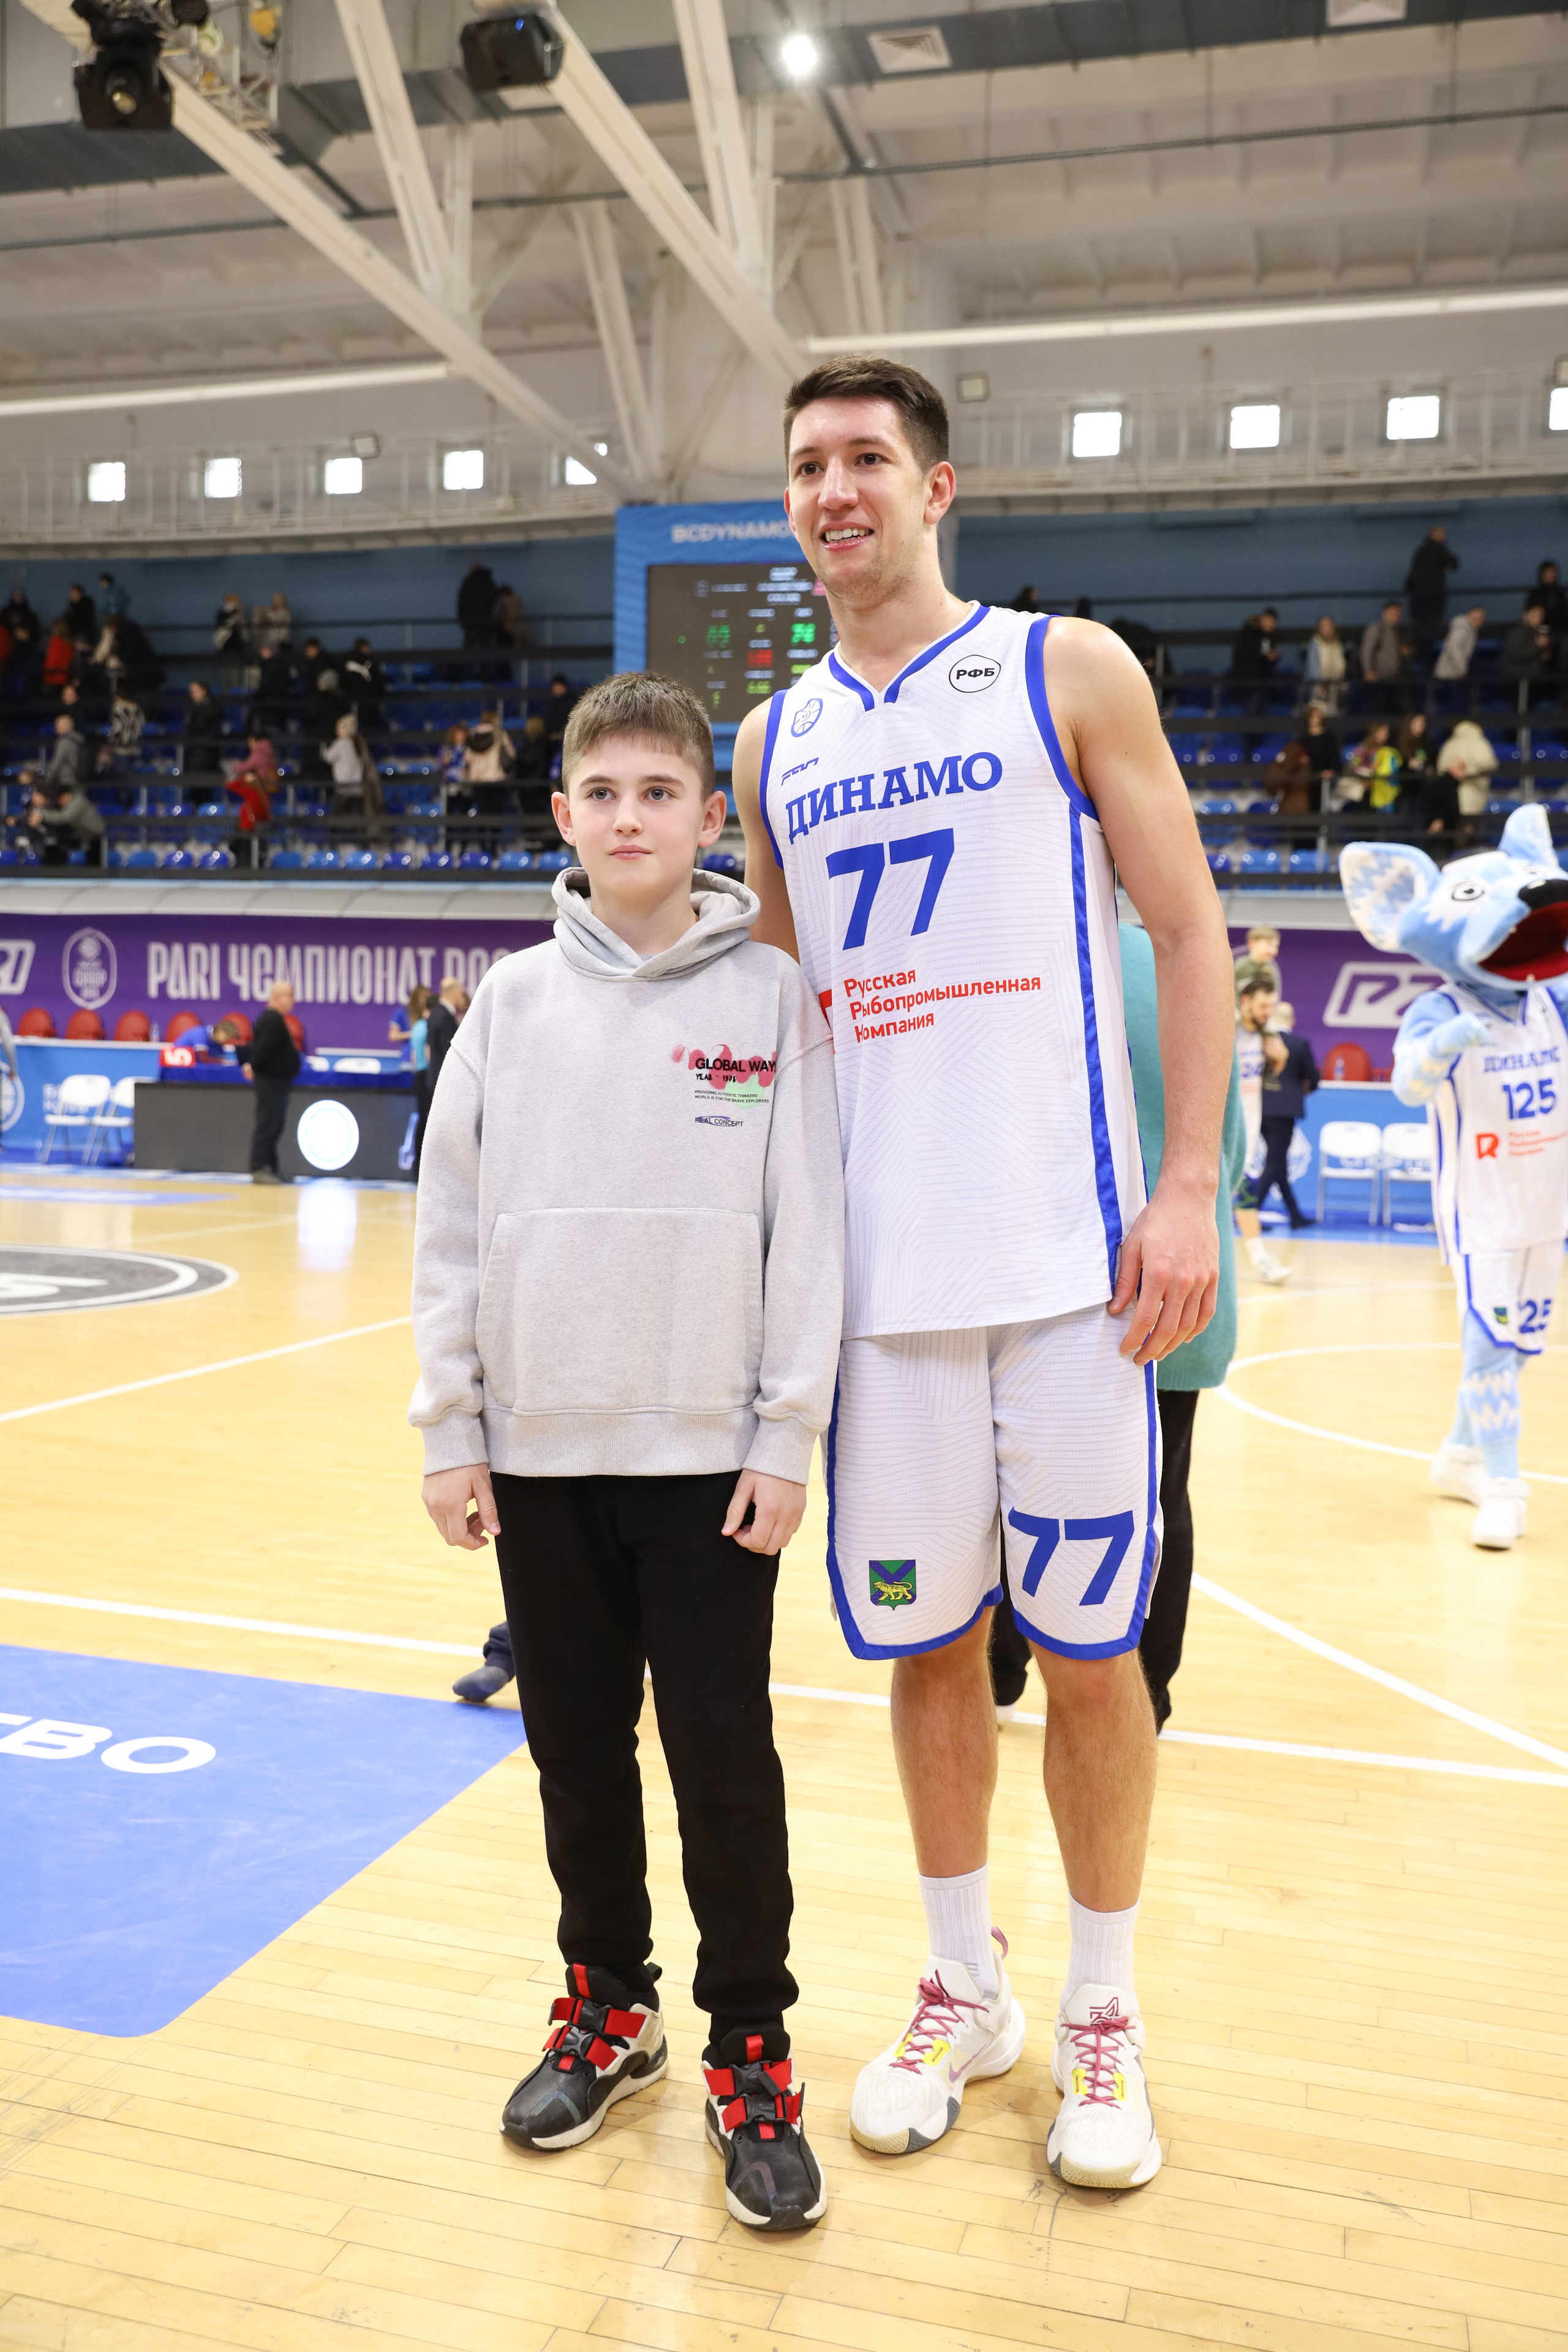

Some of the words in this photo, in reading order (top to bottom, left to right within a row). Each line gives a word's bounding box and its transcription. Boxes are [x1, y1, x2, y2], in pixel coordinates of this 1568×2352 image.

[956, 668, 995, 680] РФБ
[786, 752, 1002, 845] ДИНАМО
[826, 828, 955, 951] 77
[148, 941, 221, 1000] PARI
[844, 970, 916, 997] Русская
[850, 977, 1041, 1020] Рыбопромышленная
[855, 1013, 934, 1042] Компания
[695, 1058, 746, 1072] GLOBAL
[1502, 1078, 1556, 1120] 125
[714, 1118, 744, 1127] CONCEPT
[1008, 1506, 1135, 1606] 77
[0, 1712, 216, 1774] ВО
